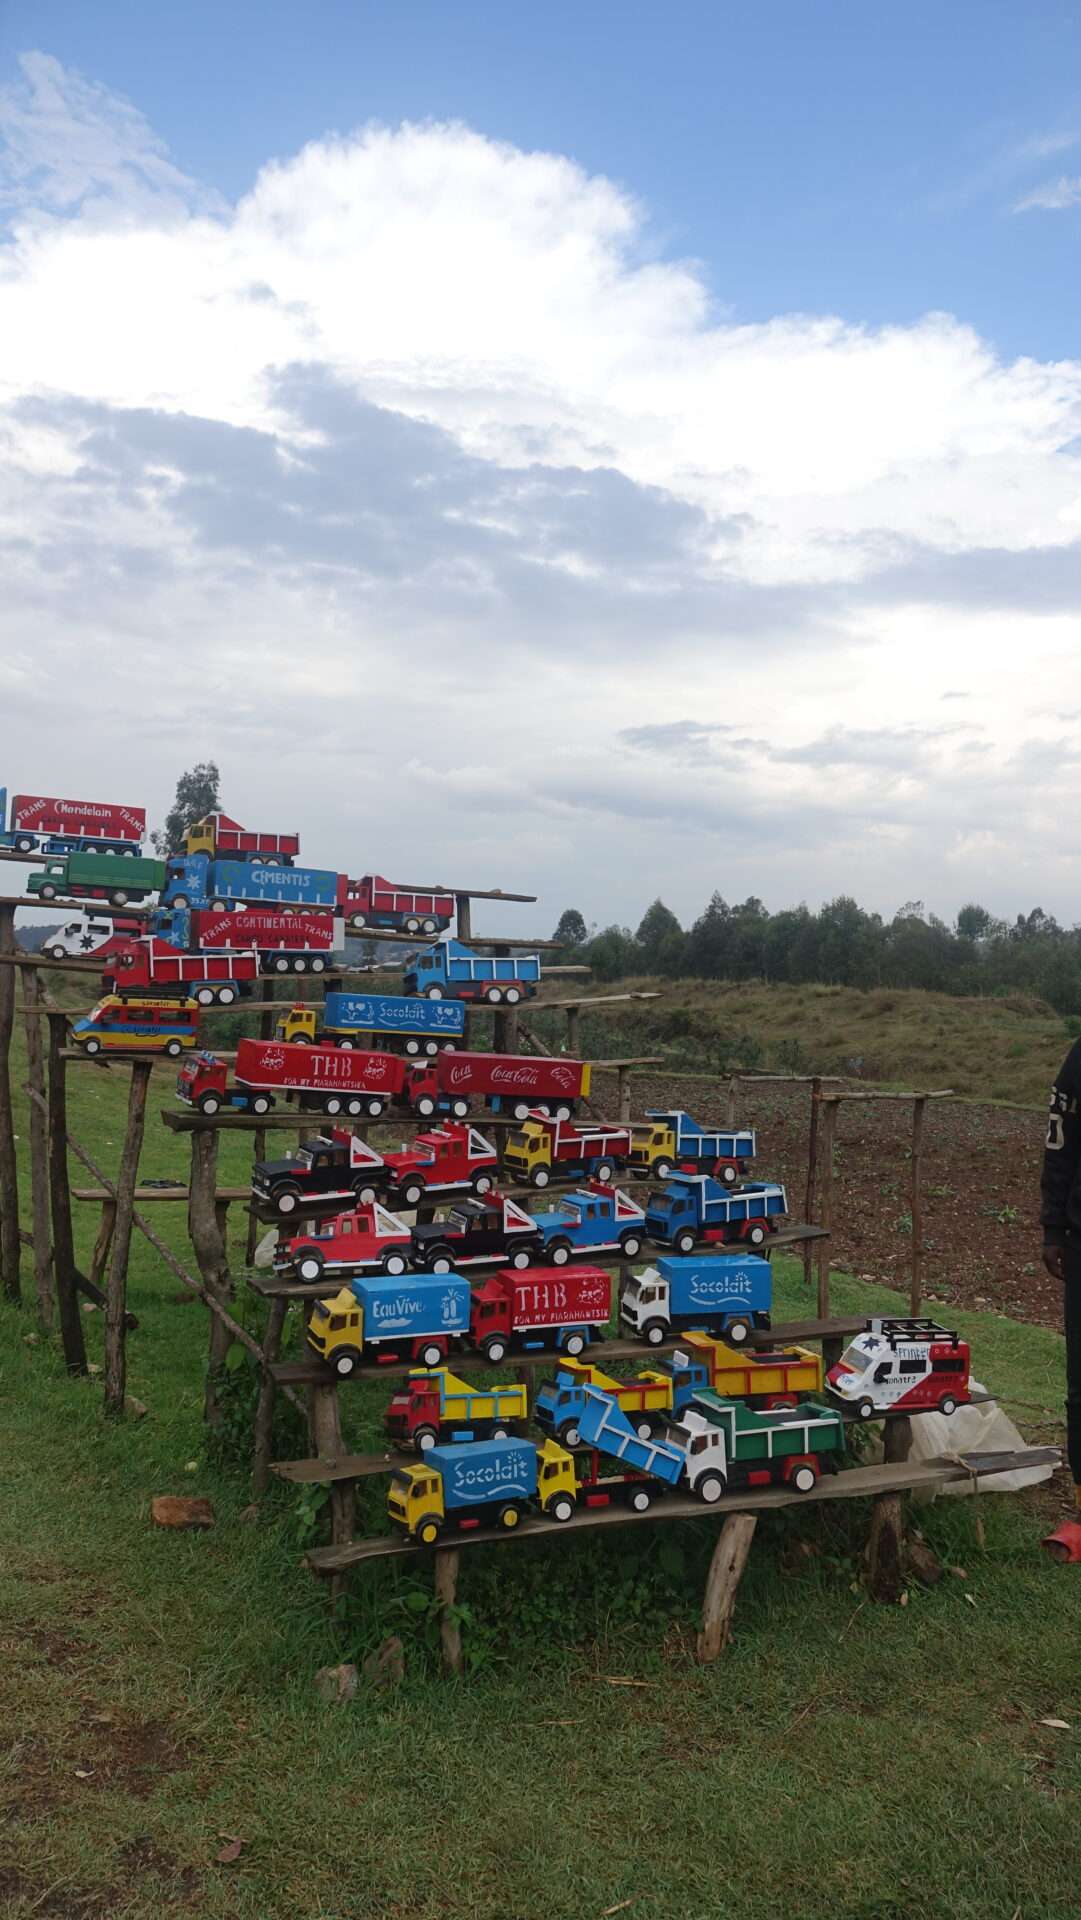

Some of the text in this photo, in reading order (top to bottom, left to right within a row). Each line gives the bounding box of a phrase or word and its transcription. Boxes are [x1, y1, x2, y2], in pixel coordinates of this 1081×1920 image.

[17, 800, 47, 820] TRANS
[119, 807, 145, 831] TRANS
[203, 918, 232, 941] TRANS
[304, 924, 334, 940] TRANS
[379, 1001, 426, 1020] Socolait
[310, 1055, 352, 1077] THB
[690, 1273, 753, 1294] Socolait
[514, 1282, 567, 1312] THB
[454, 1458, 529, 1487] Socolait
